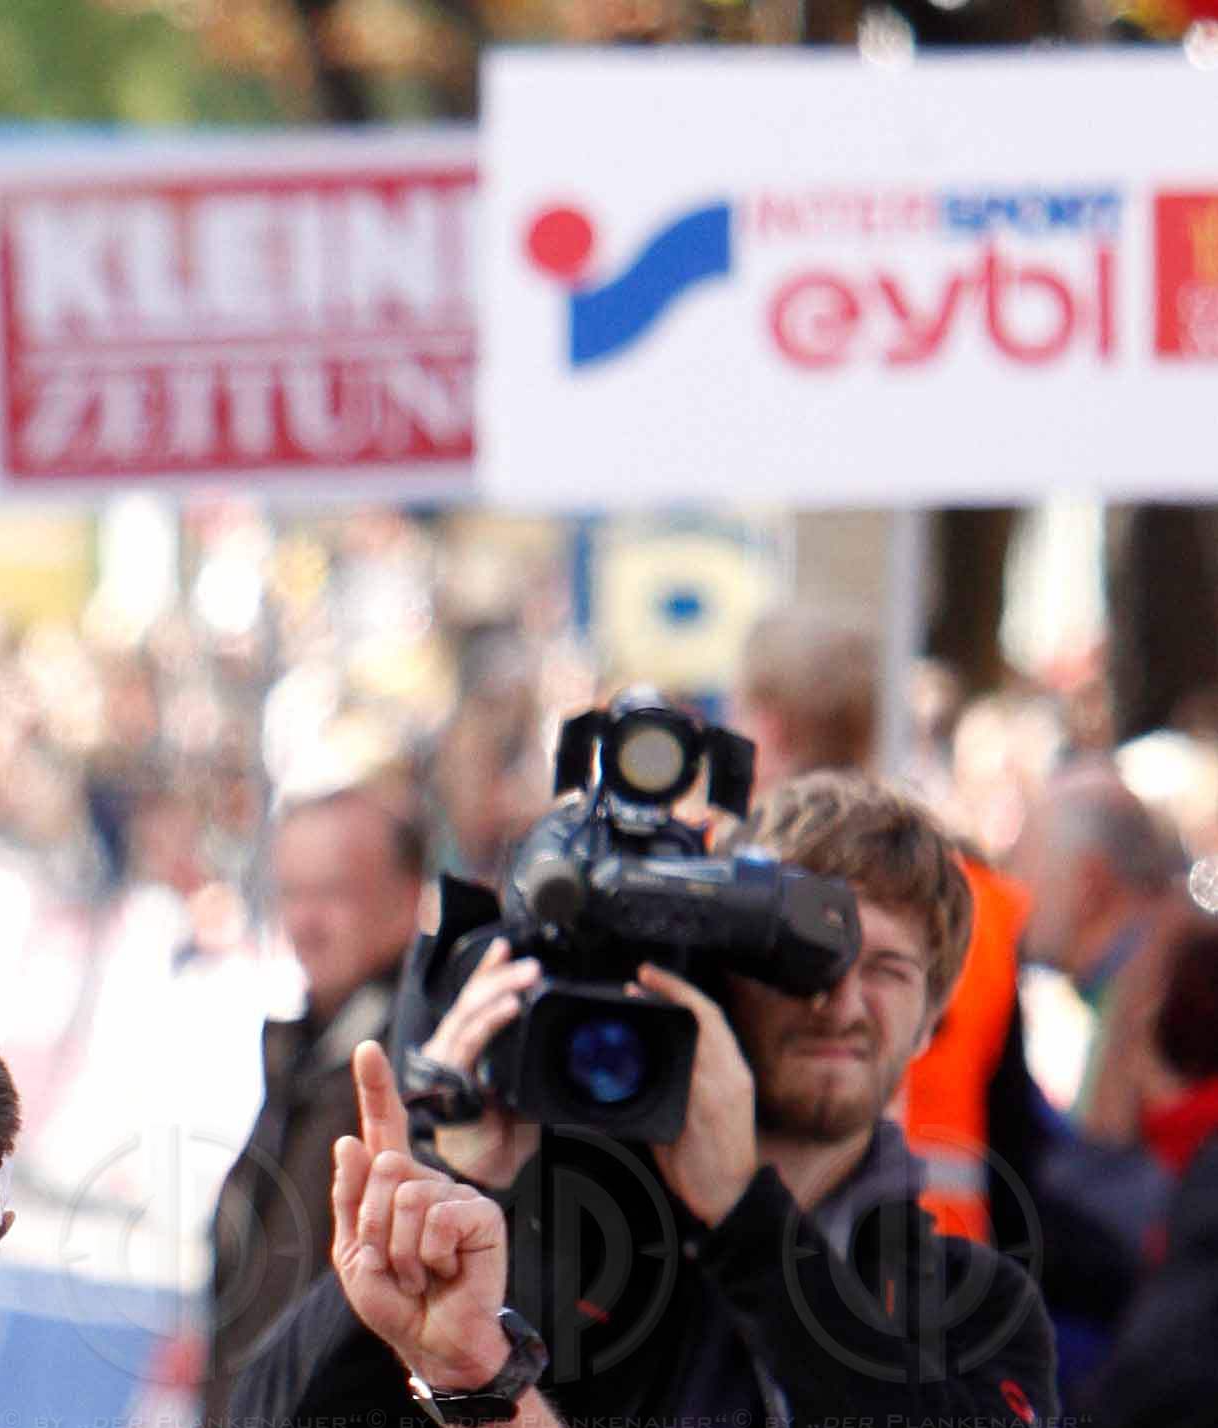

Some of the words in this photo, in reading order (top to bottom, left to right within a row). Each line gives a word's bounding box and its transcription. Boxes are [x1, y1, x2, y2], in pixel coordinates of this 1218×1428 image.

[20, 192, 479, 342] KLEIN
[772, 242, 1114, 370] eybl
[22, 356, 477, 470] ZEITUN
